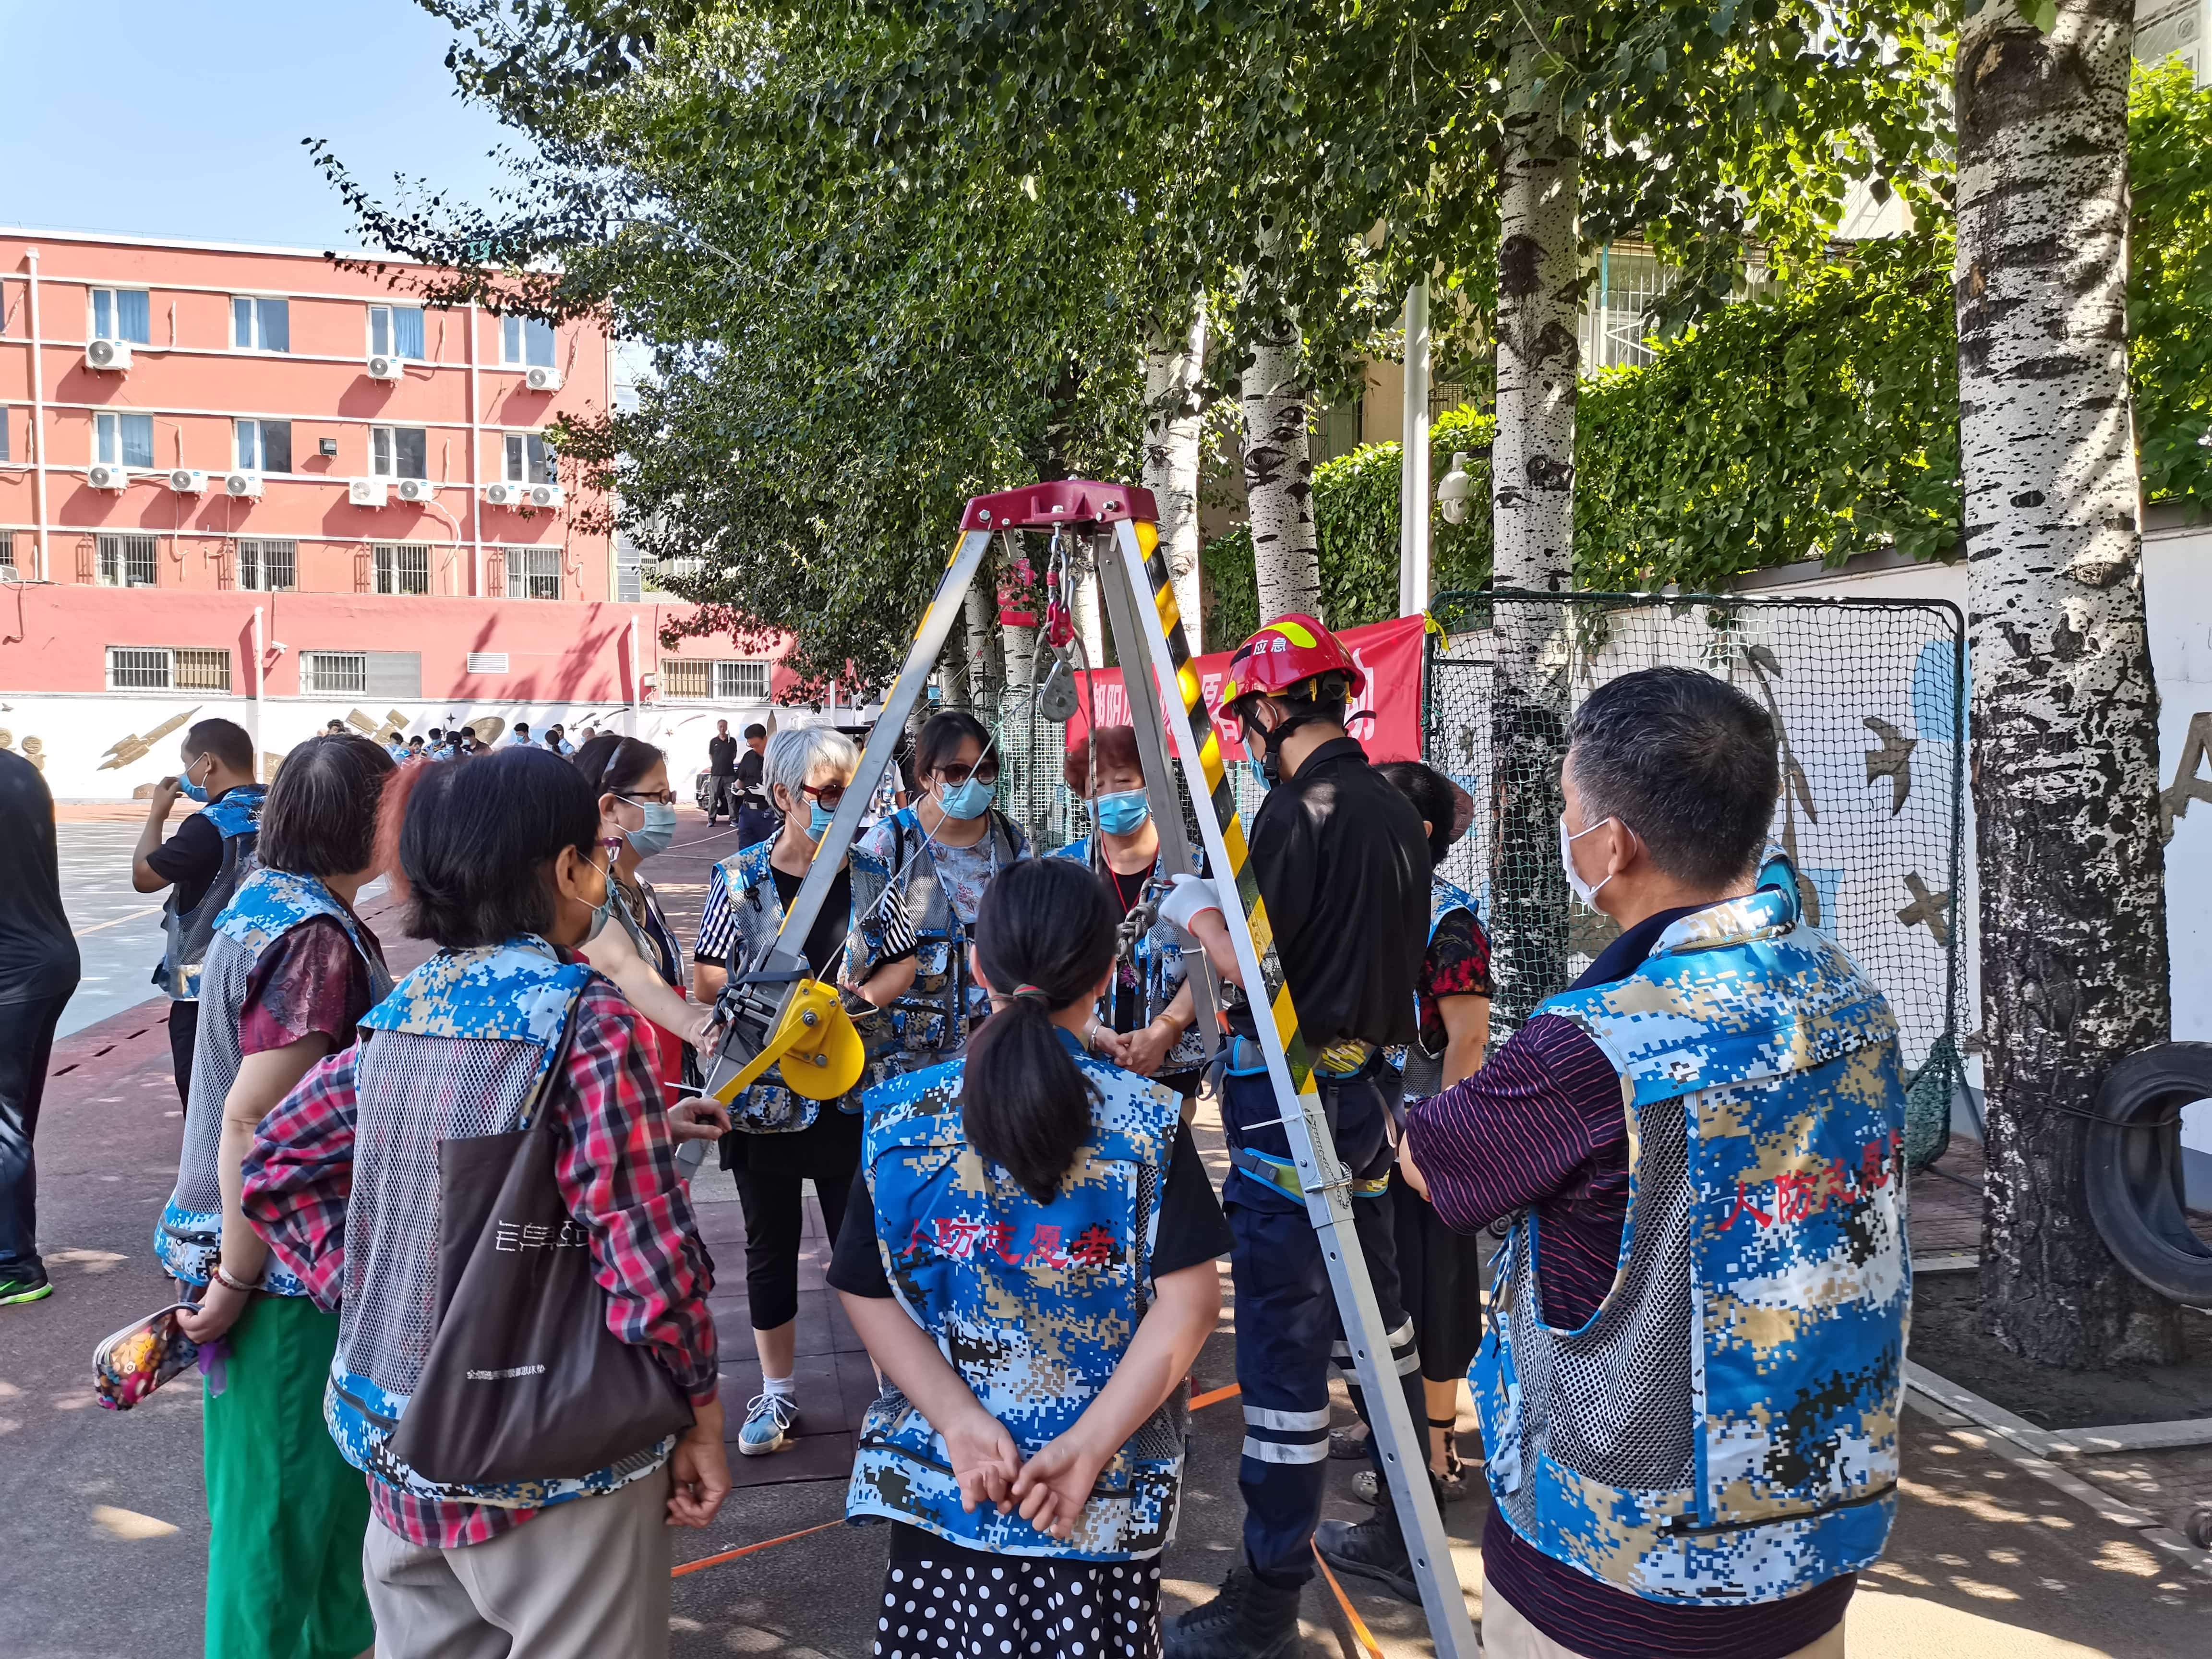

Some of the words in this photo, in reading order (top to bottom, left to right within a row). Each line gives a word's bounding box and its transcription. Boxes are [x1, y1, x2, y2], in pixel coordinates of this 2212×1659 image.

[903, 1217, 1115, 1269] 人防志愿者
